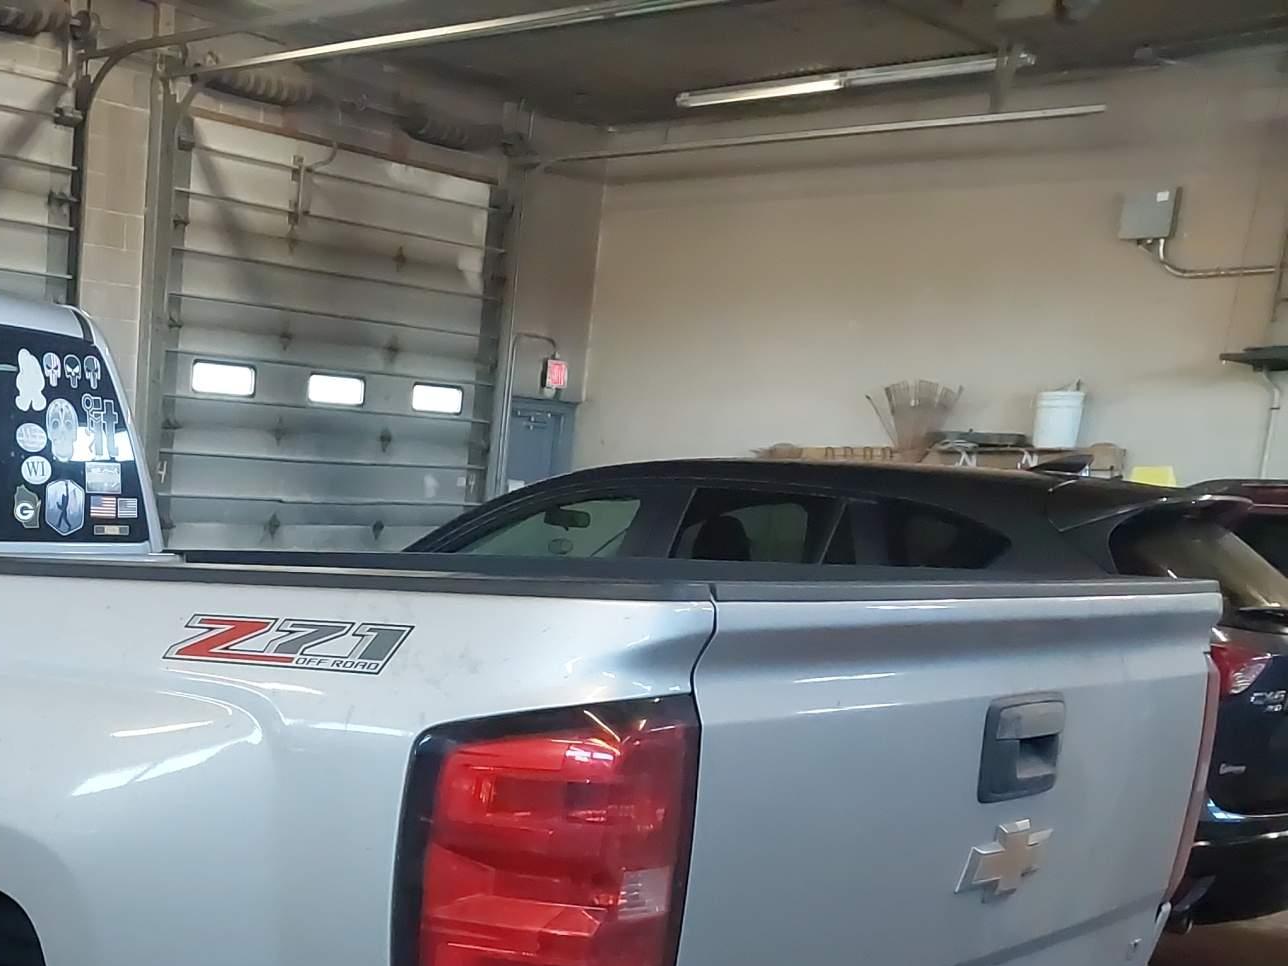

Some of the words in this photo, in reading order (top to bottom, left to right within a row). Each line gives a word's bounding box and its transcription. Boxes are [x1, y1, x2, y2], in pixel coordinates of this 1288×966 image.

[26, 461, 46, 477] WI
[162, 613, 416, 674] Z71
[295, 657, 330, 668] OFF
[331, 659, 379, 671] ROAD
